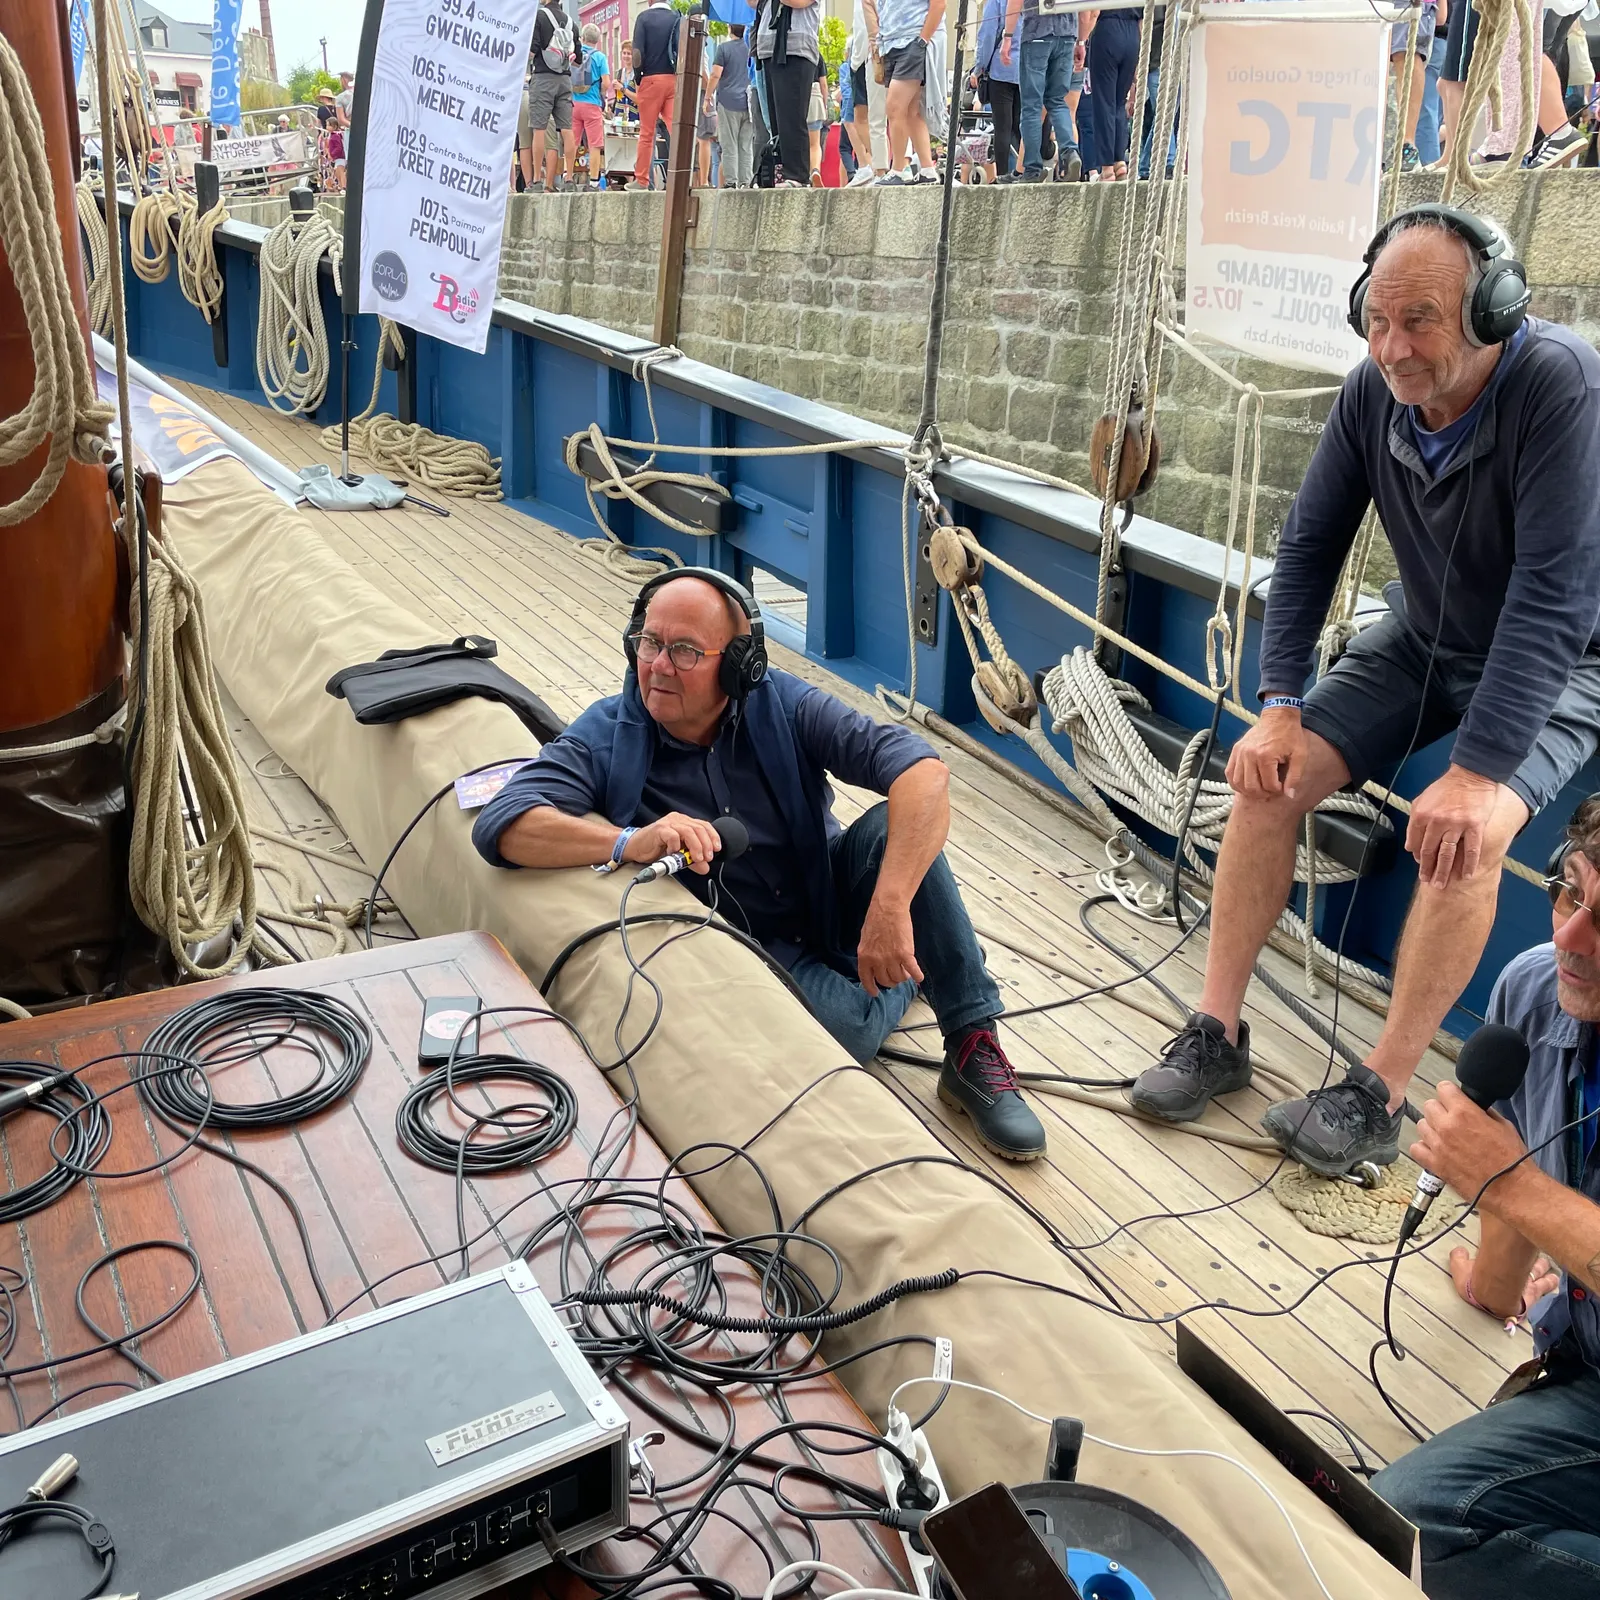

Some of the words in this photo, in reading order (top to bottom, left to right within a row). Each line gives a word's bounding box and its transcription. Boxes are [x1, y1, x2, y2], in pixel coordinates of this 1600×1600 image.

[426, 14, 515, 63] GWENGAMP
[442, 0, 476, 22] 99.4
[477, 11, 520, 34] Guingamp
[412, 54, 446, 85] 106.5
[447, 73, 474, 91] Monts
[475, 84, 506, 102] d'Arrée
[417, 84, 465, 121] MENEZ
[470, 106, 501, 134] ARE
[396, 124, 427, 154] 102.9
[428, 142, 457, 160] Centre
[458, 152, 492, 172] Bretagne
[398, 147, 435, 180] KREIZ
[439, 164, 491, 200] BREIZH
[409, 218, 480, 261] PEMPOULL
[420, 196, 449, 225] 107.5
[451, 216, 485, 235] Paimpol
[514, 1405, 545, 1421] PRO
